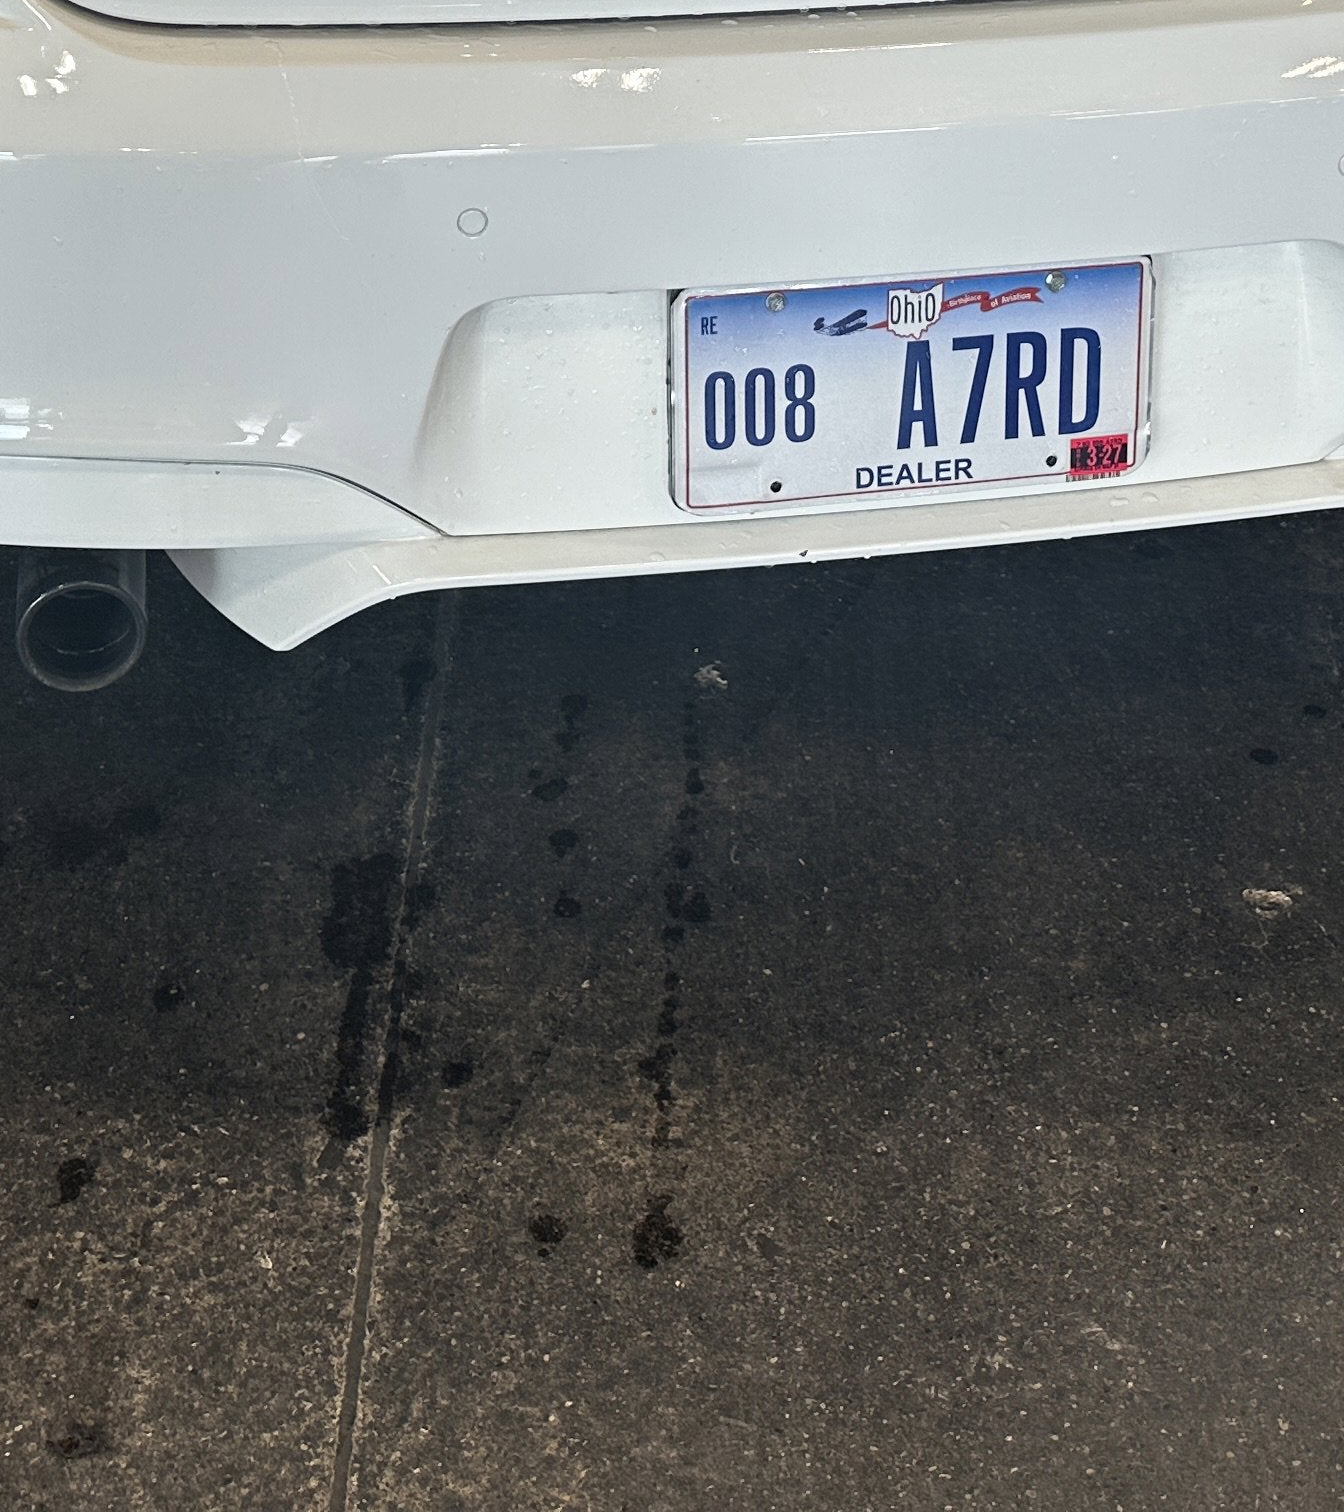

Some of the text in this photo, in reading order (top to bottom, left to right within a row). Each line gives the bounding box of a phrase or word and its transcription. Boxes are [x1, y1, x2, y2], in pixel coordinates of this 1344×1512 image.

[948, 291, 1032, 308] Birthplace of Aviation
[701, 316, 718, 335] RE
[704, 327, 1101, 450] 008 A7RD
[857, 458, 974, 489] DEALER
